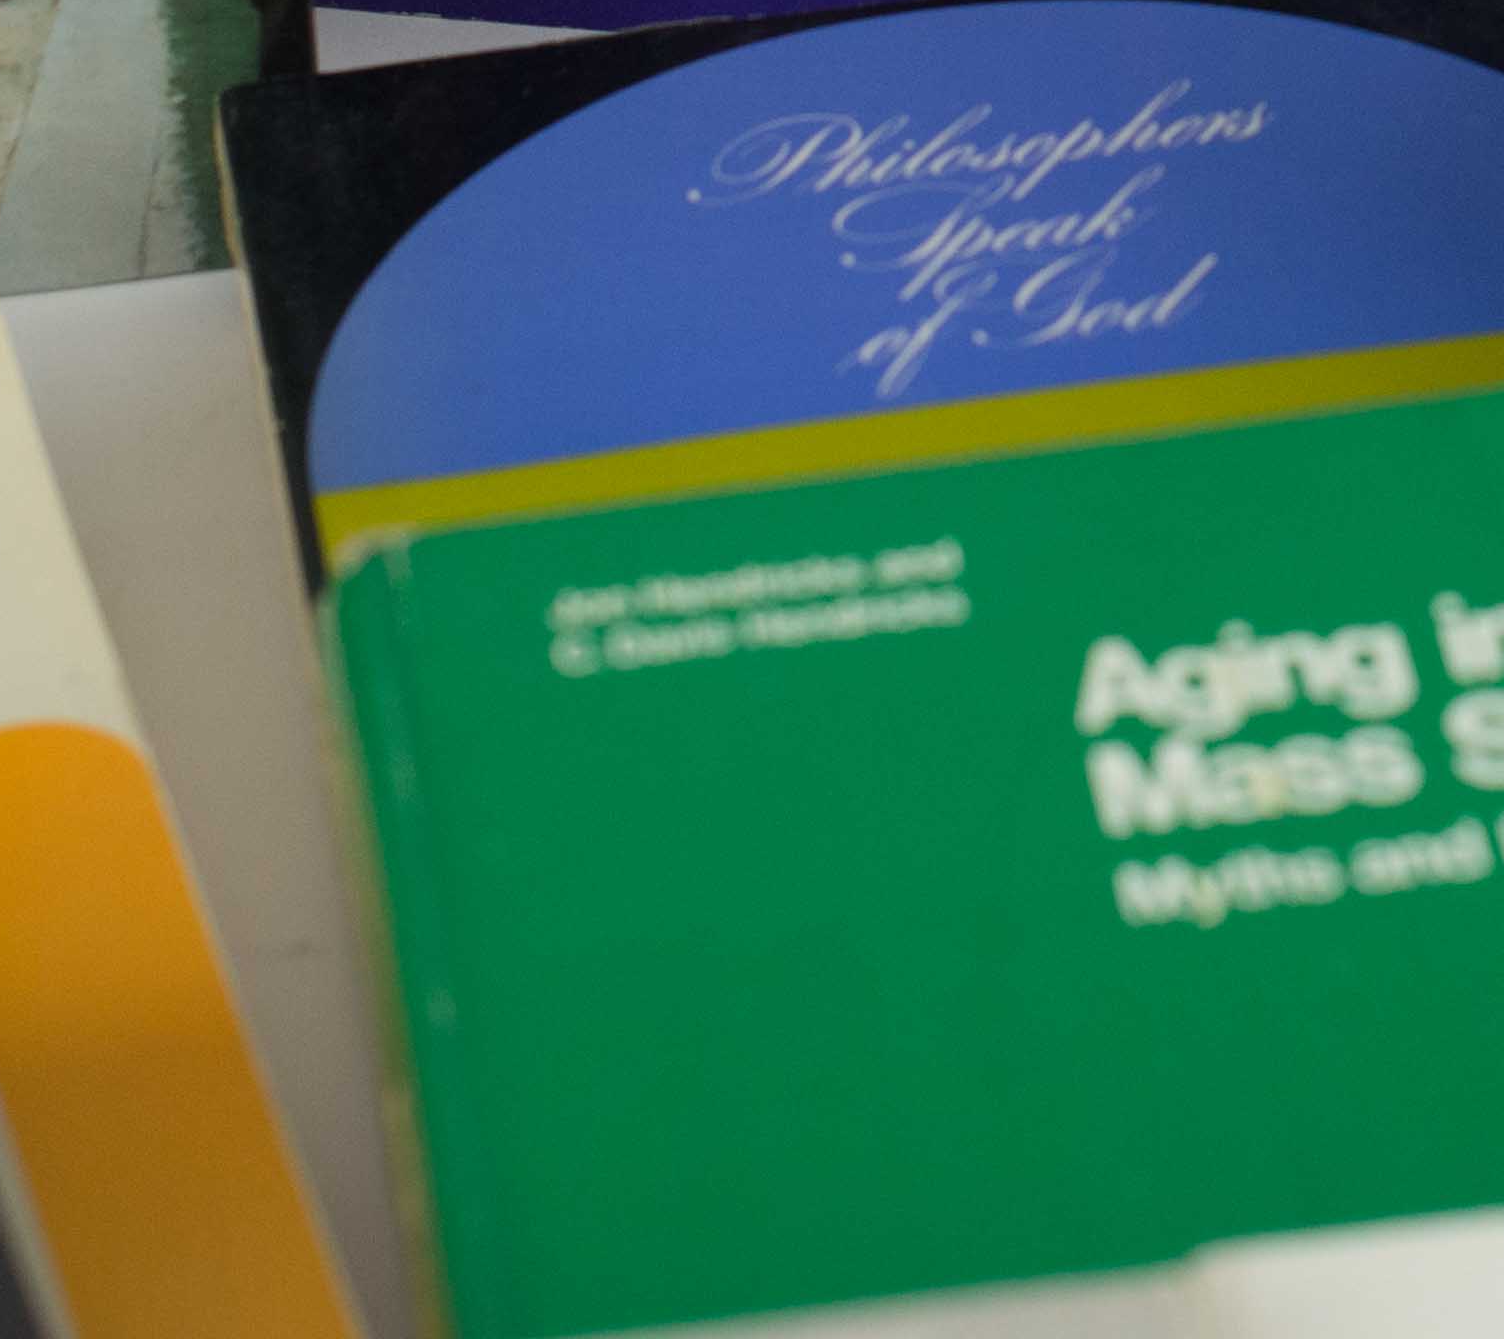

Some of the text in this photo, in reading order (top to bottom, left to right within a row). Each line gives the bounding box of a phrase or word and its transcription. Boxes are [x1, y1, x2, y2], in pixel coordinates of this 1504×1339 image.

[686, 77, 1272, 207] Philosophers
[831, 163, 1166, 303] Speak
[836, 243, 1219, 399] of God
[1076, 617, 1418, 740] Aging
[1084, 723, 1425, 839] Mass
[1113, 845, 1347, 927] Myths
[1349, 815, 1494, 896] and
